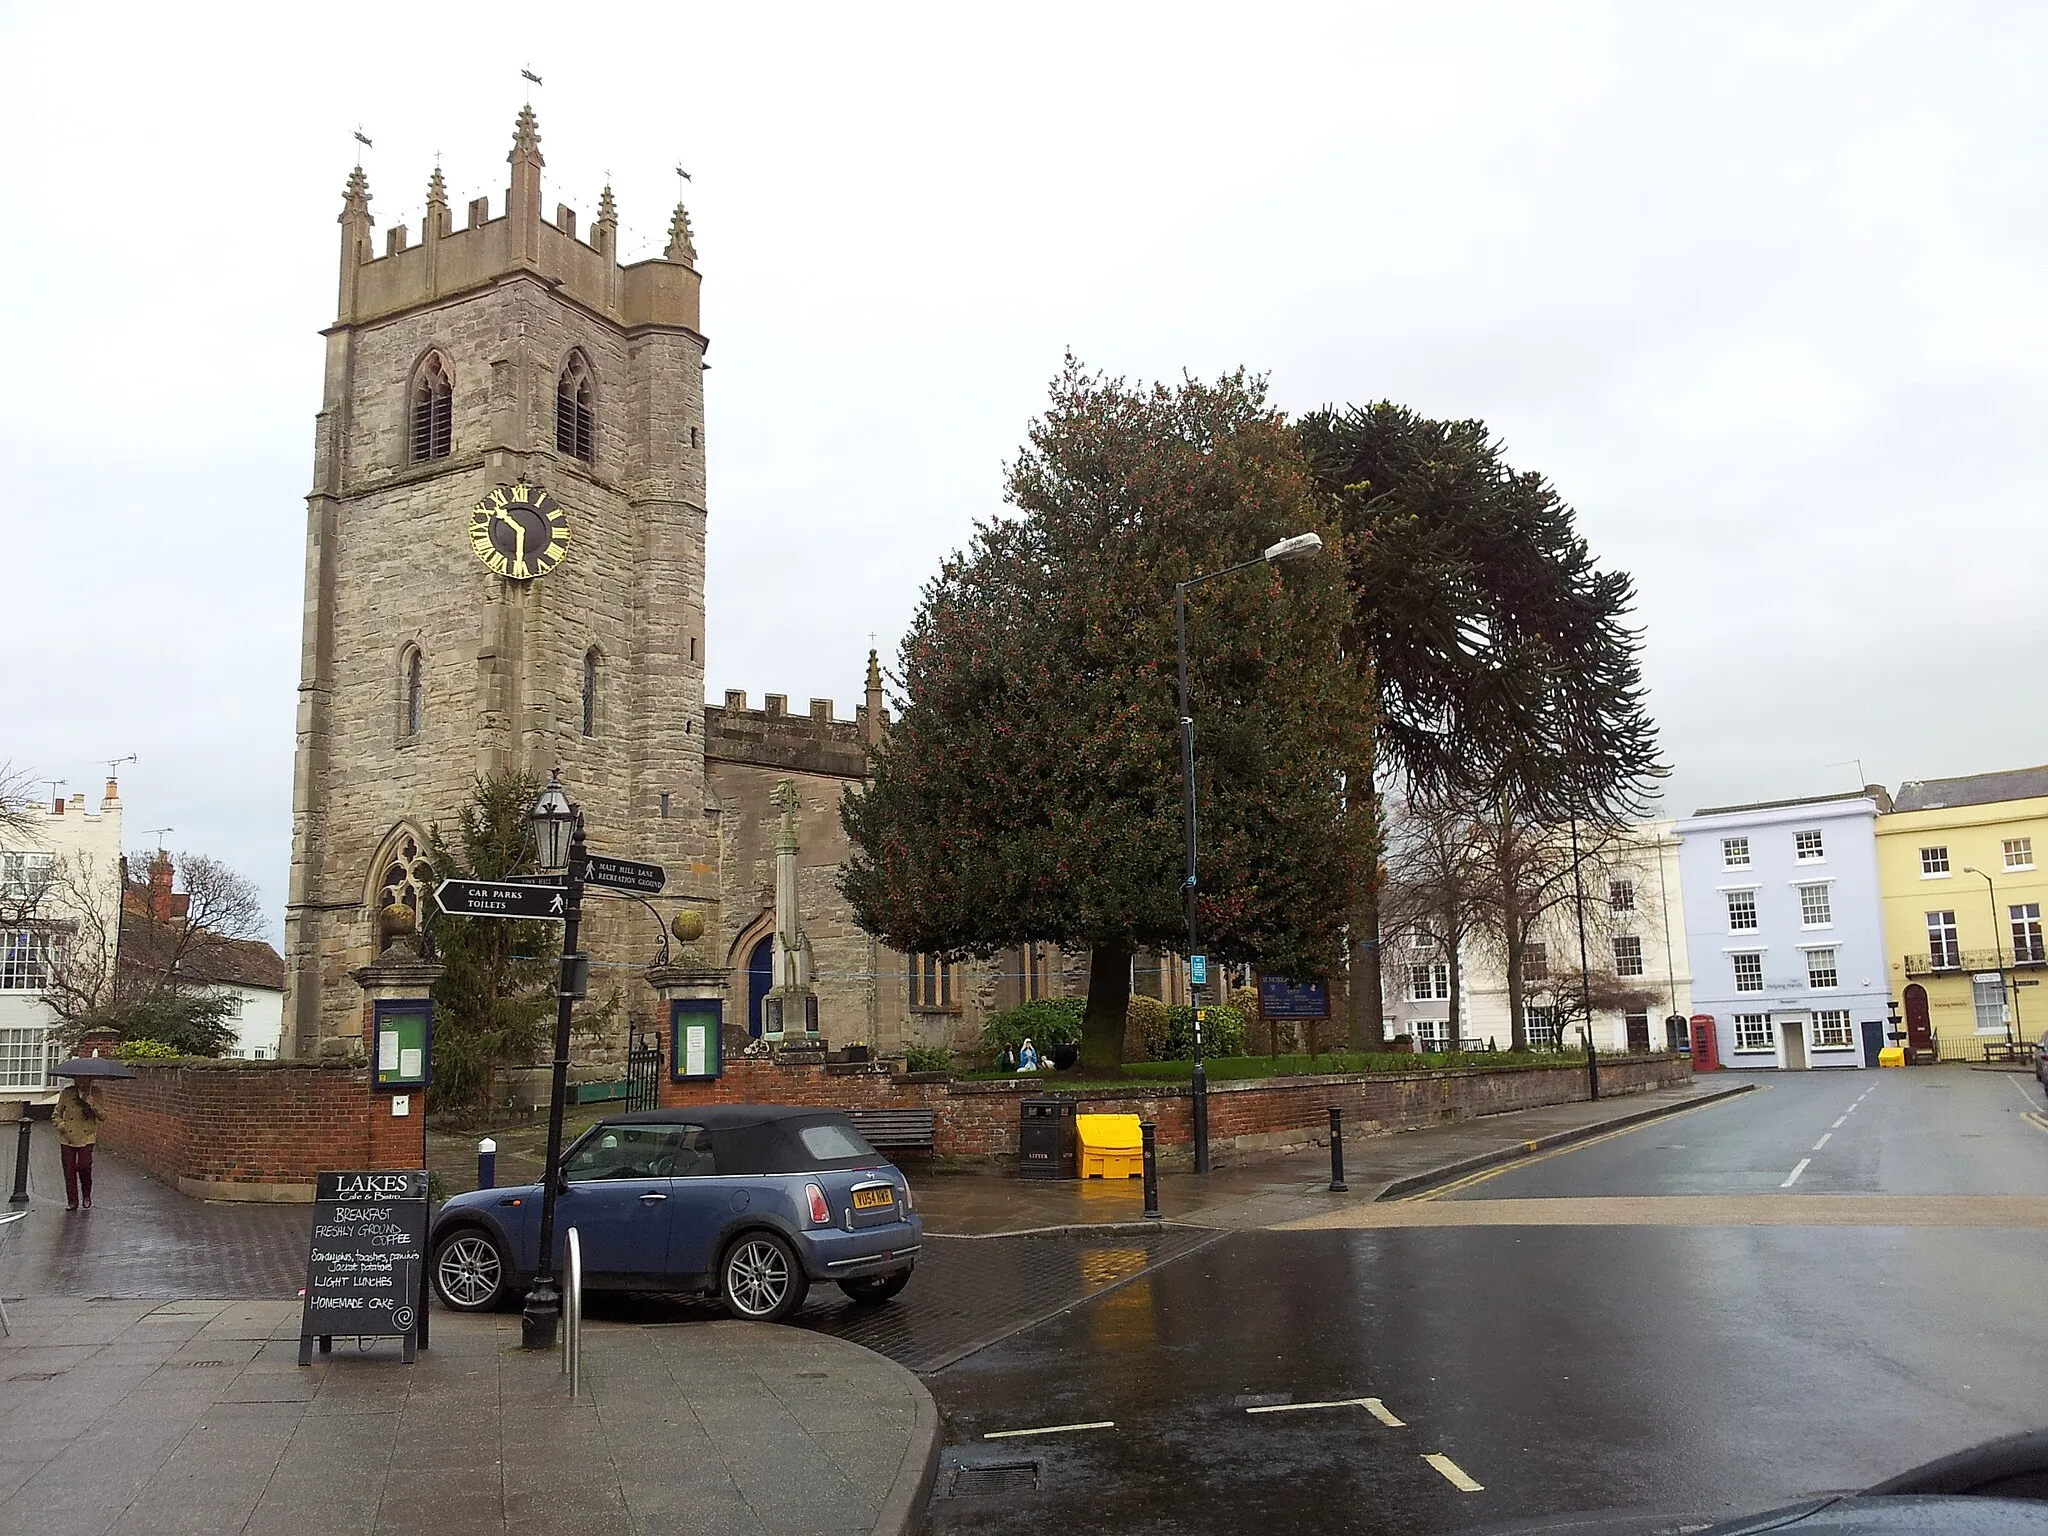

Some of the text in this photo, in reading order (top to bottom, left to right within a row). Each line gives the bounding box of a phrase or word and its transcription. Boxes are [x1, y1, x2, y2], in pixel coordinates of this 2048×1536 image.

[599, 862, 653, 878] MALT MILL LANE
[598, 872, 663, 889] RECREATION GROUND
[468, 889, 523, 899] CAR PARKS
[468, 900, 506, 909] TOILETS
[335, 1175, 408, 1192] LAKES
[339, 1192, 363, 1201] Cafe
[374, 1192, 401, 1201] Bistro
[333, 1207, 392, 1223] BREAKFAST
[315, 1223, 402, 1238] FRESHLY GROUND
[371, 1233, 412, 1246] COFFEE
[328, 1260, 393, 1274] Jacket potatoes
[314, 1275, 393, 1287] LIGHT LUNCHES
[310, 1296, 395, 1310] HOMEMADE CAKE
